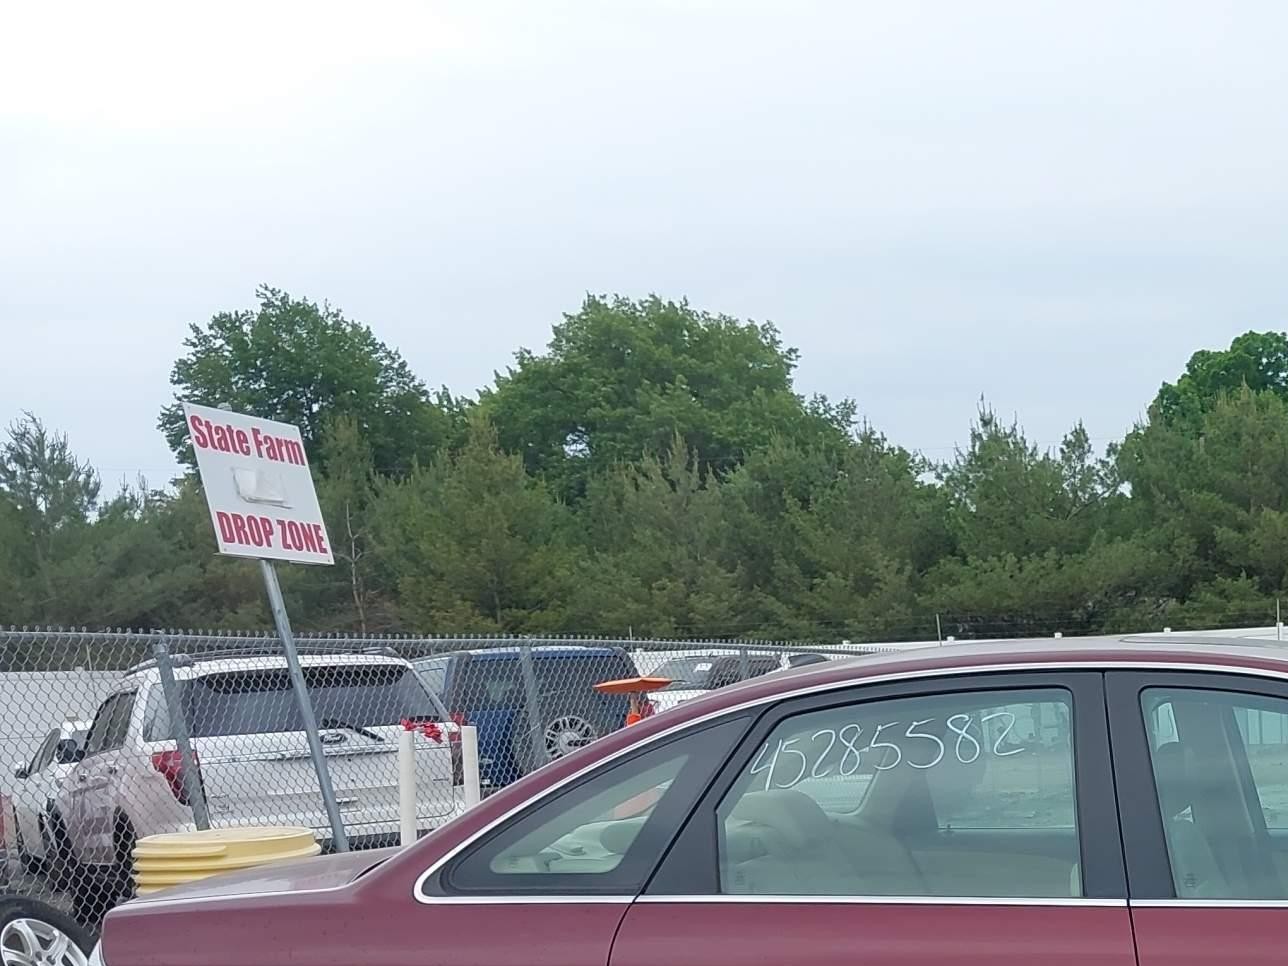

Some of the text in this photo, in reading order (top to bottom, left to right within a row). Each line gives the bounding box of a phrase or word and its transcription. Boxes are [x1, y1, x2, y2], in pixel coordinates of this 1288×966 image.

[189, 415, 305, 466] State Farm
[216, 511, 328, 554] DROP ZONE
[750, 712, 1025, 791] 45285582
